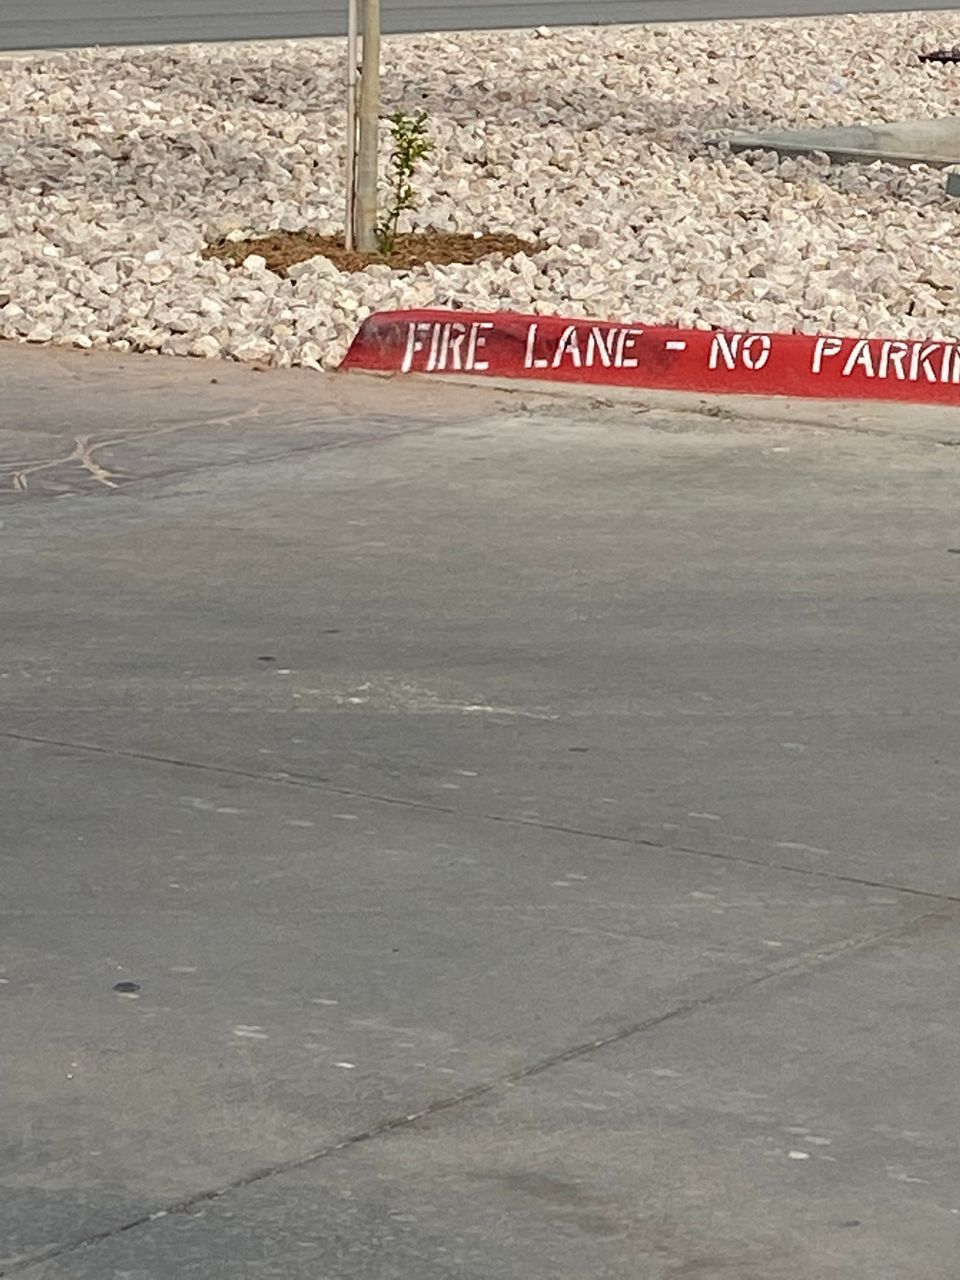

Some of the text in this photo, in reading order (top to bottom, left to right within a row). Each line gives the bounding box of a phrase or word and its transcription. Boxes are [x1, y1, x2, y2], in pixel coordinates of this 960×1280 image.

[402, 322, 494, 372] FIRE
[524, 323, 644, 369] LANE
[708, 333, 772, 370] NO
